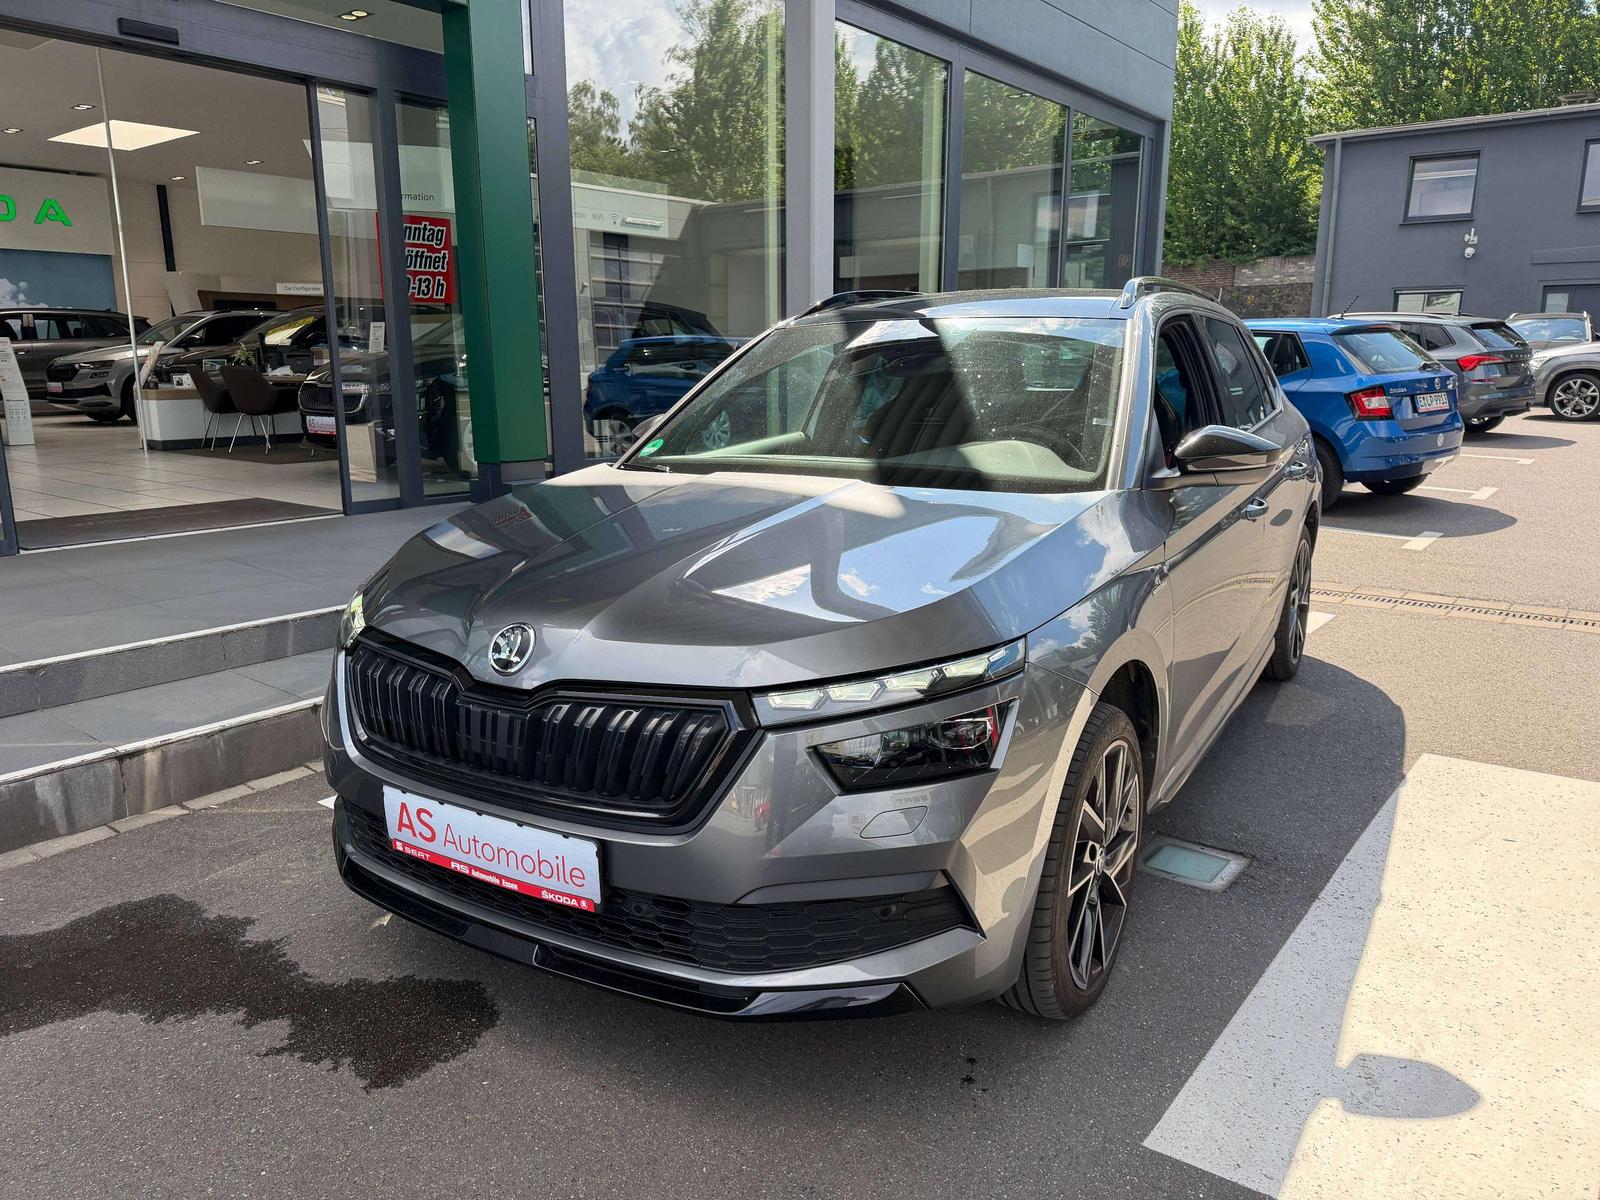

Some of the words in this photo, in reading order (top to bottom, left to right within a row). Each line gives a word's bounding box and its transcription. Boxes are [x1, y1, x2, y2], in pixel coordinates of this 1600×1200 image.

[403, 222, 446, 248] nntag
[405, 248, 448, 272] öffnet
[434, 276, 446, 299] h
[397, 801, 437, 843] AS
[443, 823, 586, 888] Automobile
[404, 846, 431, 860] SEAT
[451, 861, 470, 874] AS
[471, 869, 500, 886] Automobile
[541, 889, 579, 907] ŠKODA
